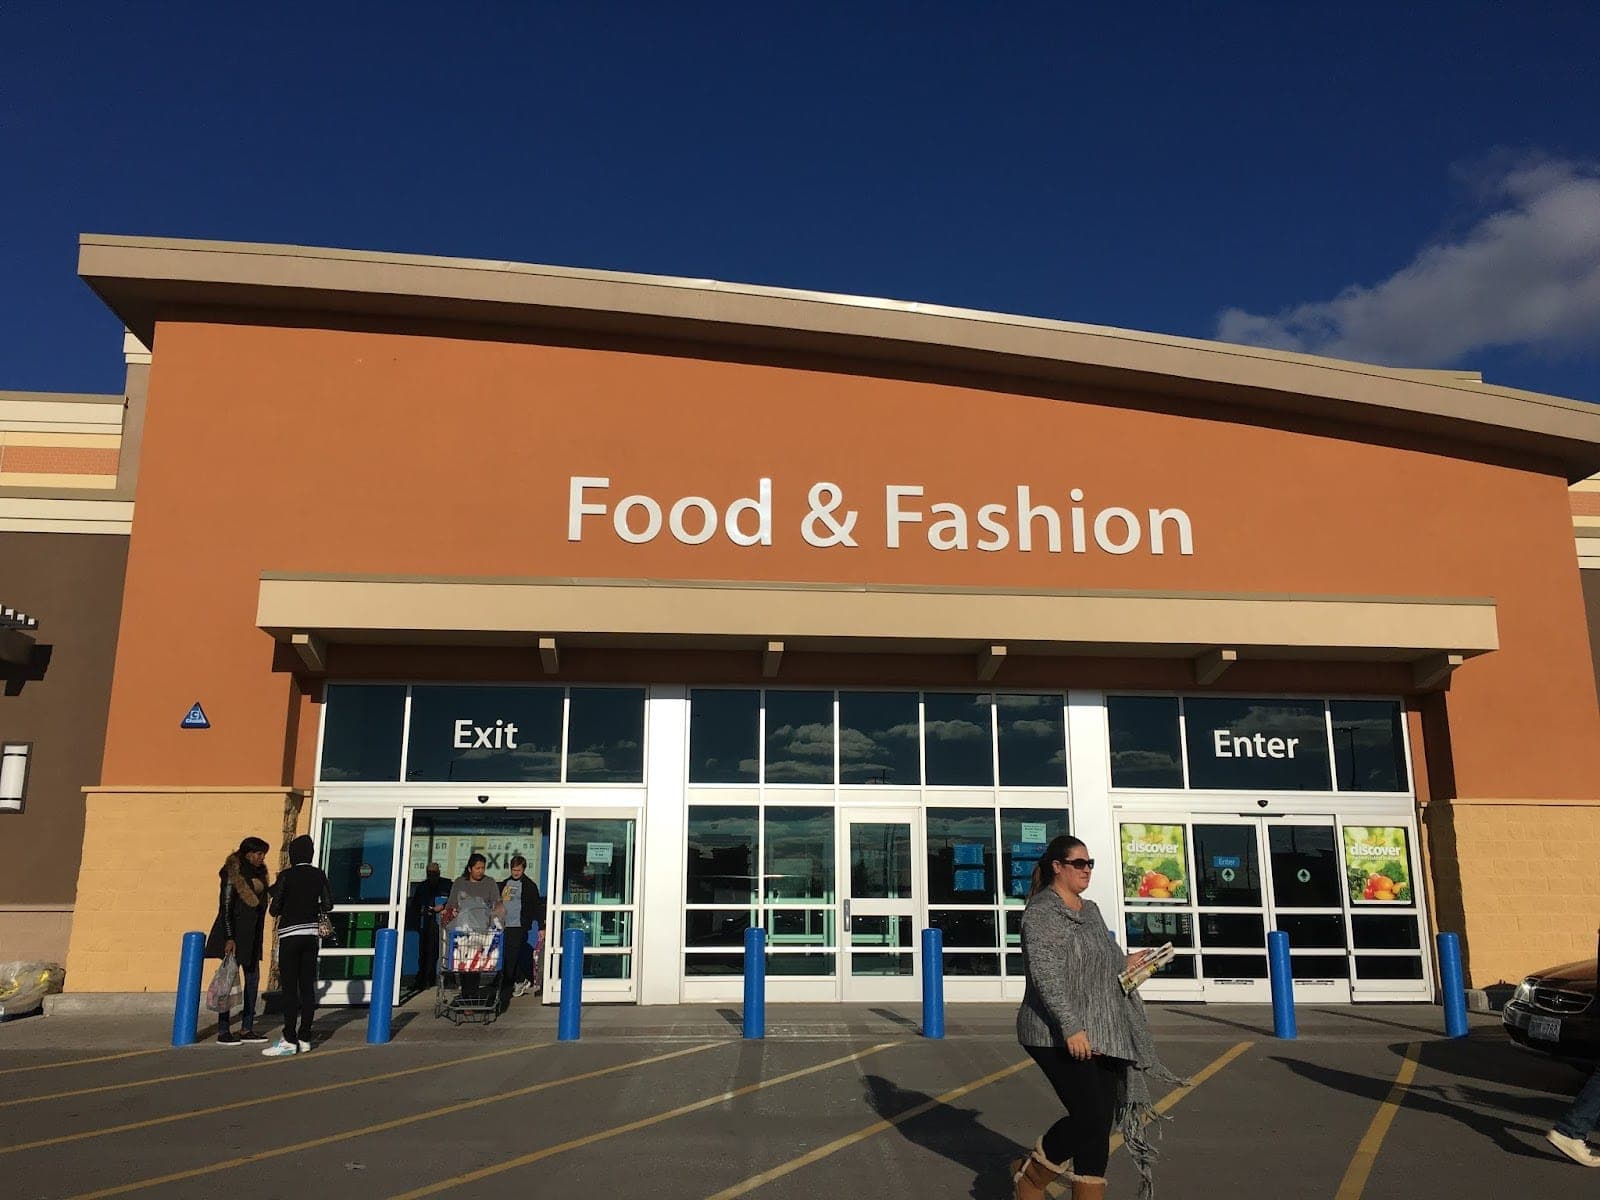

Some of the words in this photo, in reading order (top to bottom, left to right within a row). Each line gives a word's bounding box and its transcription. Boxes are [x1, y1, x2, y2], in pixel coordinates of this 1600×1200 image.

[568, 475, 773, 547] Food
[800, 481, 859, 549] &
[885, 484, 1194, 556] Fashion
[453, 719, 519, 749] Exit
[1213, 729, 1300, 759] Enter
[1127, 839, 1179, 854] discover
[1350, 842, 1401, 856] discover
